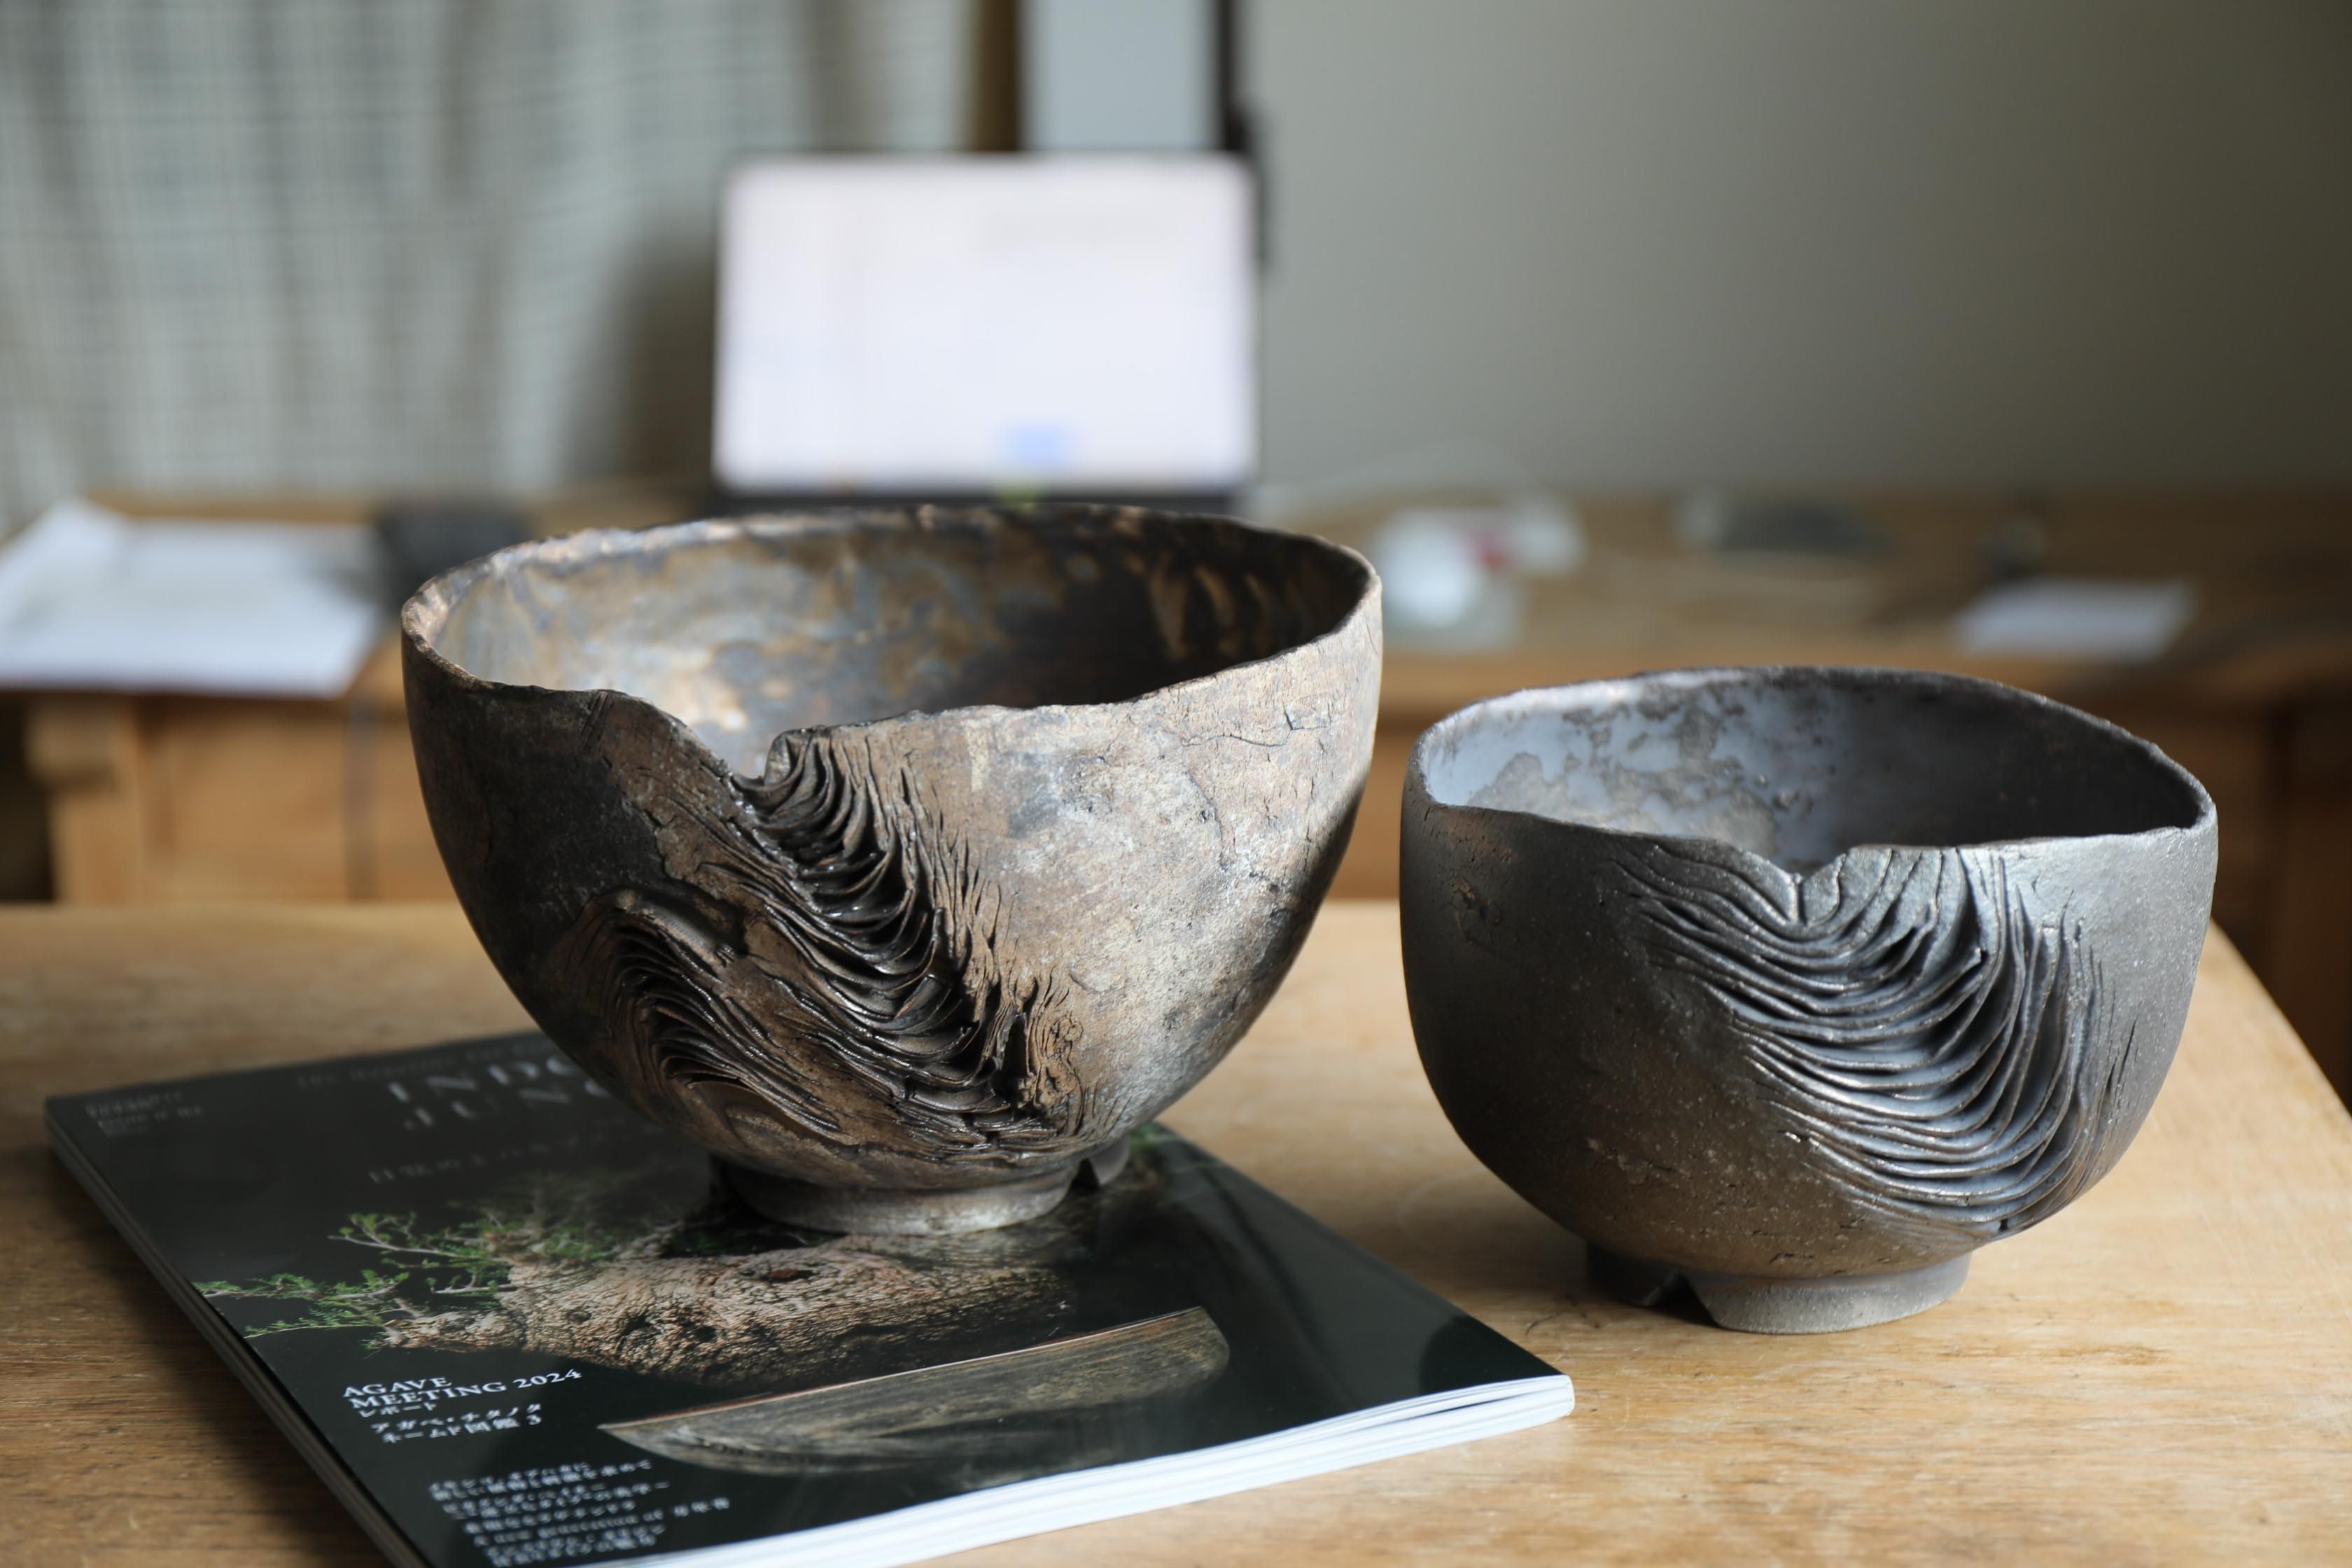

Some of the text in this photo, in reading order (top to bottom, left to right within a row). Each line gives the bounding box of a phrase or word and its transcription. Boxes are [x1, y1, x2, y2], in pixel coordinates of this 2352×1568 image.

[343, 1377, 451, 1397] AGAVE
[349, 1368, 582, 1408] MEETING 2024
